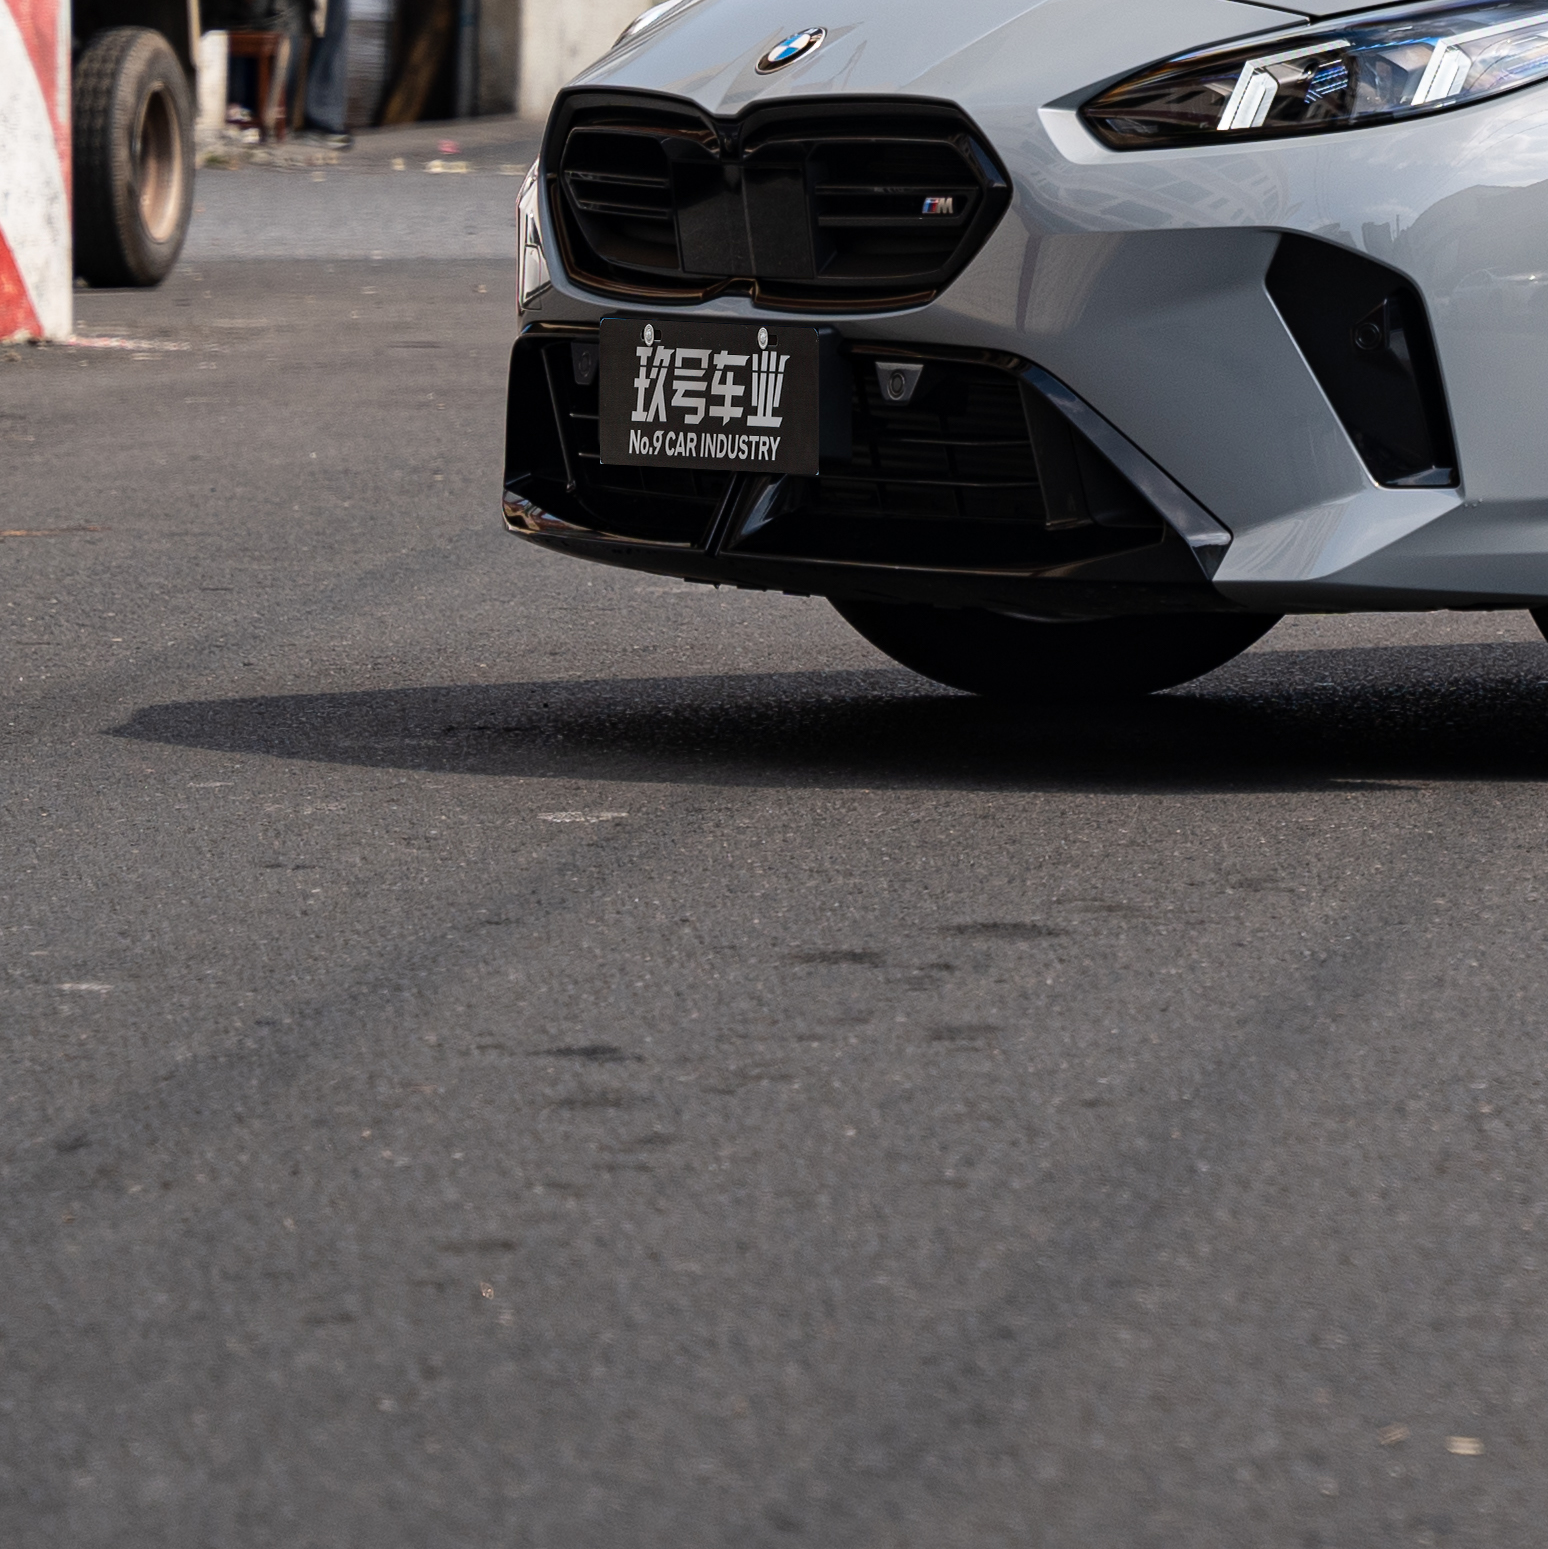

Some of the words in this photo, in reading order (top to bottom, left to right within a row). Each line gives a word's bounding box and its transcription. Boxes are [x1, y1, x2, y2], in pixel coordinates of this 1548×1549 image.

[631, 345, 791, 428] 玖号车业
[628, 429, 665, 455] No.9
[665, 431, 697, 457] CAR
[700, 433, 781, 461] INDUSTRY
